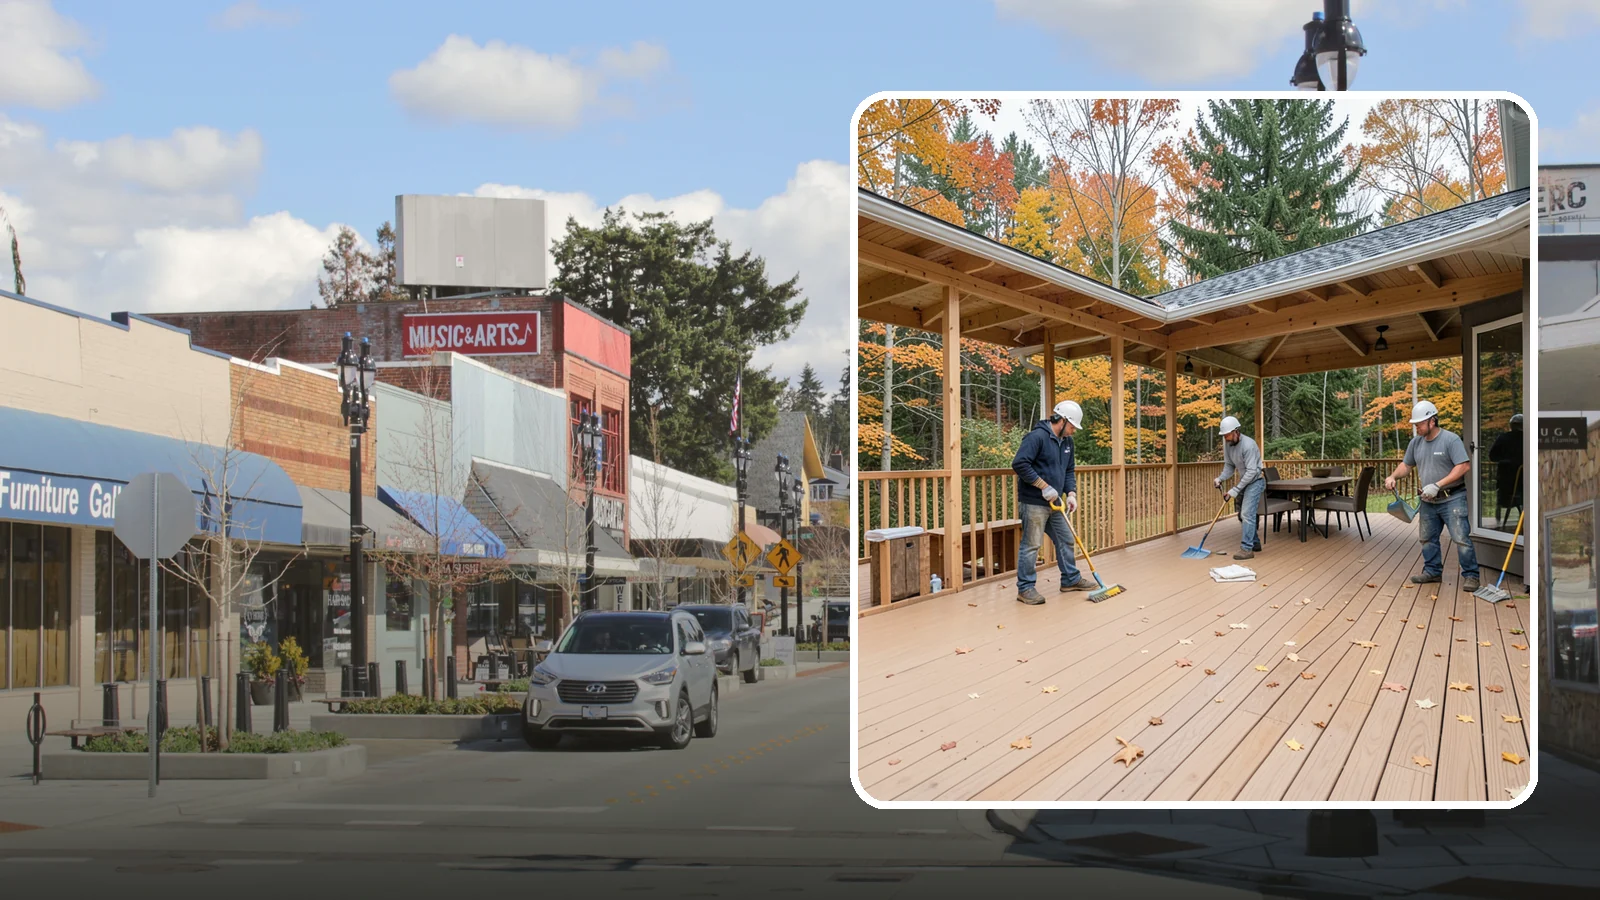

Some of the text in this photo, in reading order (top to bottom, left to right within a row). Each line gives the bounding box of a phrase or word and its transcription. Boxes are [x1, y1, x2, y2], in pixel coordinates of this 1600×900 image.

[1540, 427, 1577, 436] UGA
[0, 471, 79, 515] Furniture
[453, 563, 480, 574] SUSHI
